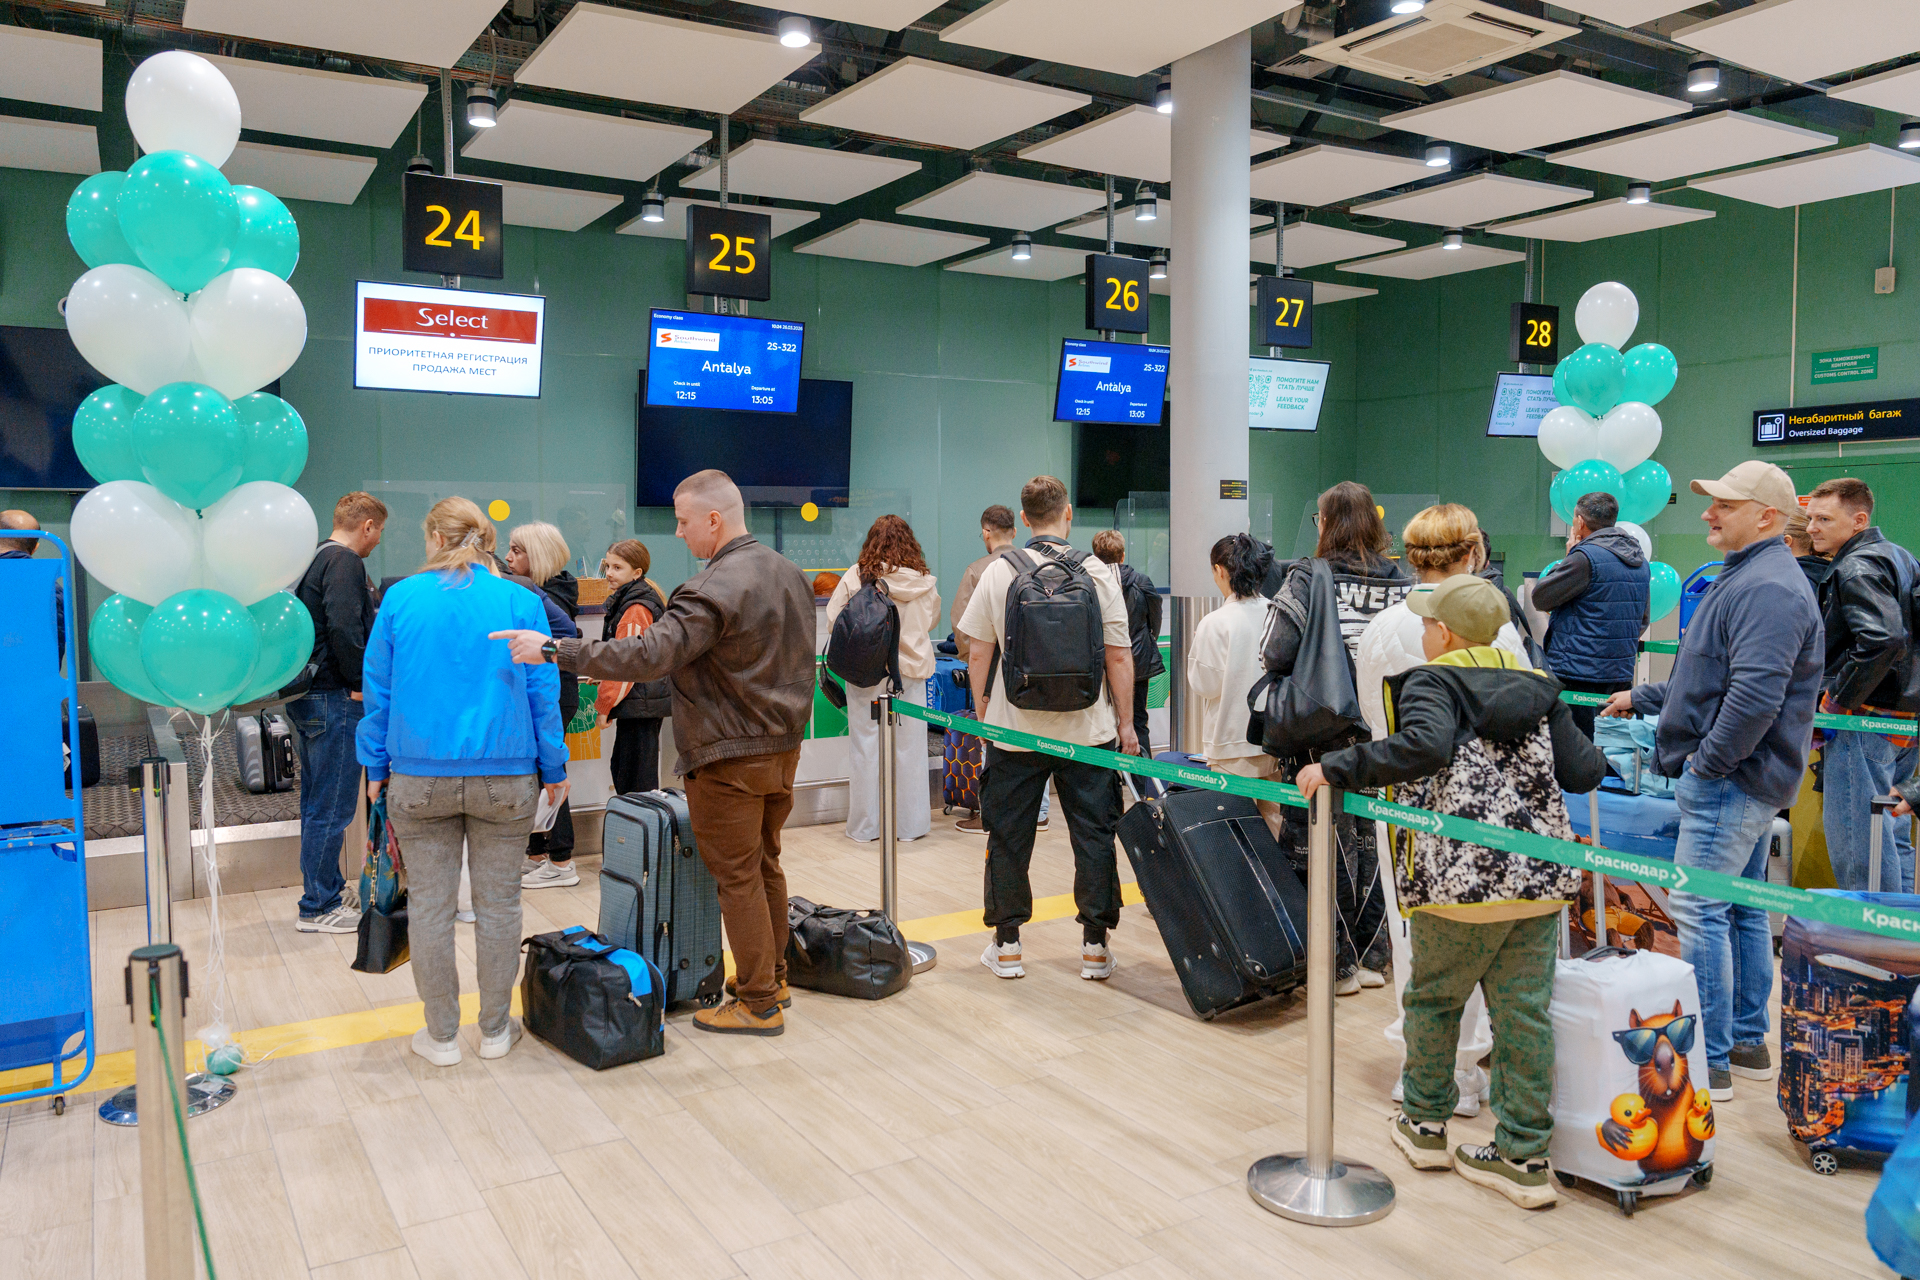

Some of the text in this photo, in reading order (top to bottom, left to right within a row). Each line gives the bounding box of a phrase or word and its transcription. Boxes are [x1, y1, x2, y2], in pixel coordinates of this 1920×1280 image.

[425, 204, 485, 250] 24
[708, 233, 755, 275] 25
[1105, 277, 1140, 312] 26
[416, 308, 488, 329] Select
[1275, 297, 1304, 328] 27
[1526, 319, 1551, 347] 28
[767, 342, 797, 353] 2S-322
[368, 347, 528, 365] ПРИОРИТЕТНАЯ РЕГИСТРАЦИЯ
[1833, 354, 1870, 362] ТАМОЖЕННОГО
[412, 364, 497, 376] ПРОДАЖА МЕСТ
[702, 360, 751, 376] Antalya
[1144, 364, 1165, 373] 2S-322
[675, 391, 696, 400] 12:15
[1095, 381, 1131, 394] Antalya
[751, 396, 773, 404] 13:05
[1129, 410, 1145, 418] 13:05
[1788, 409, 1902, 425] Негабаритный багаж
[1788, 426, 1863, 437] Oversized Baggage
[922, 710, 947, 722] Krasnodar
[1861, 718, 1918, 733] Краснодар
[1037, 739, 1068, 755] Краснодар
[1178, 769, 1217, 784] Krasnodar
[1368, 801, 1429, 827] Краснодар
[1584, 850, 1669, 881] Краснодар
[1732, 880, 1814, 902] международный
[1748, 895, 1794, 911] аэропорт
[1862, 907, 1920, 933] Красн
